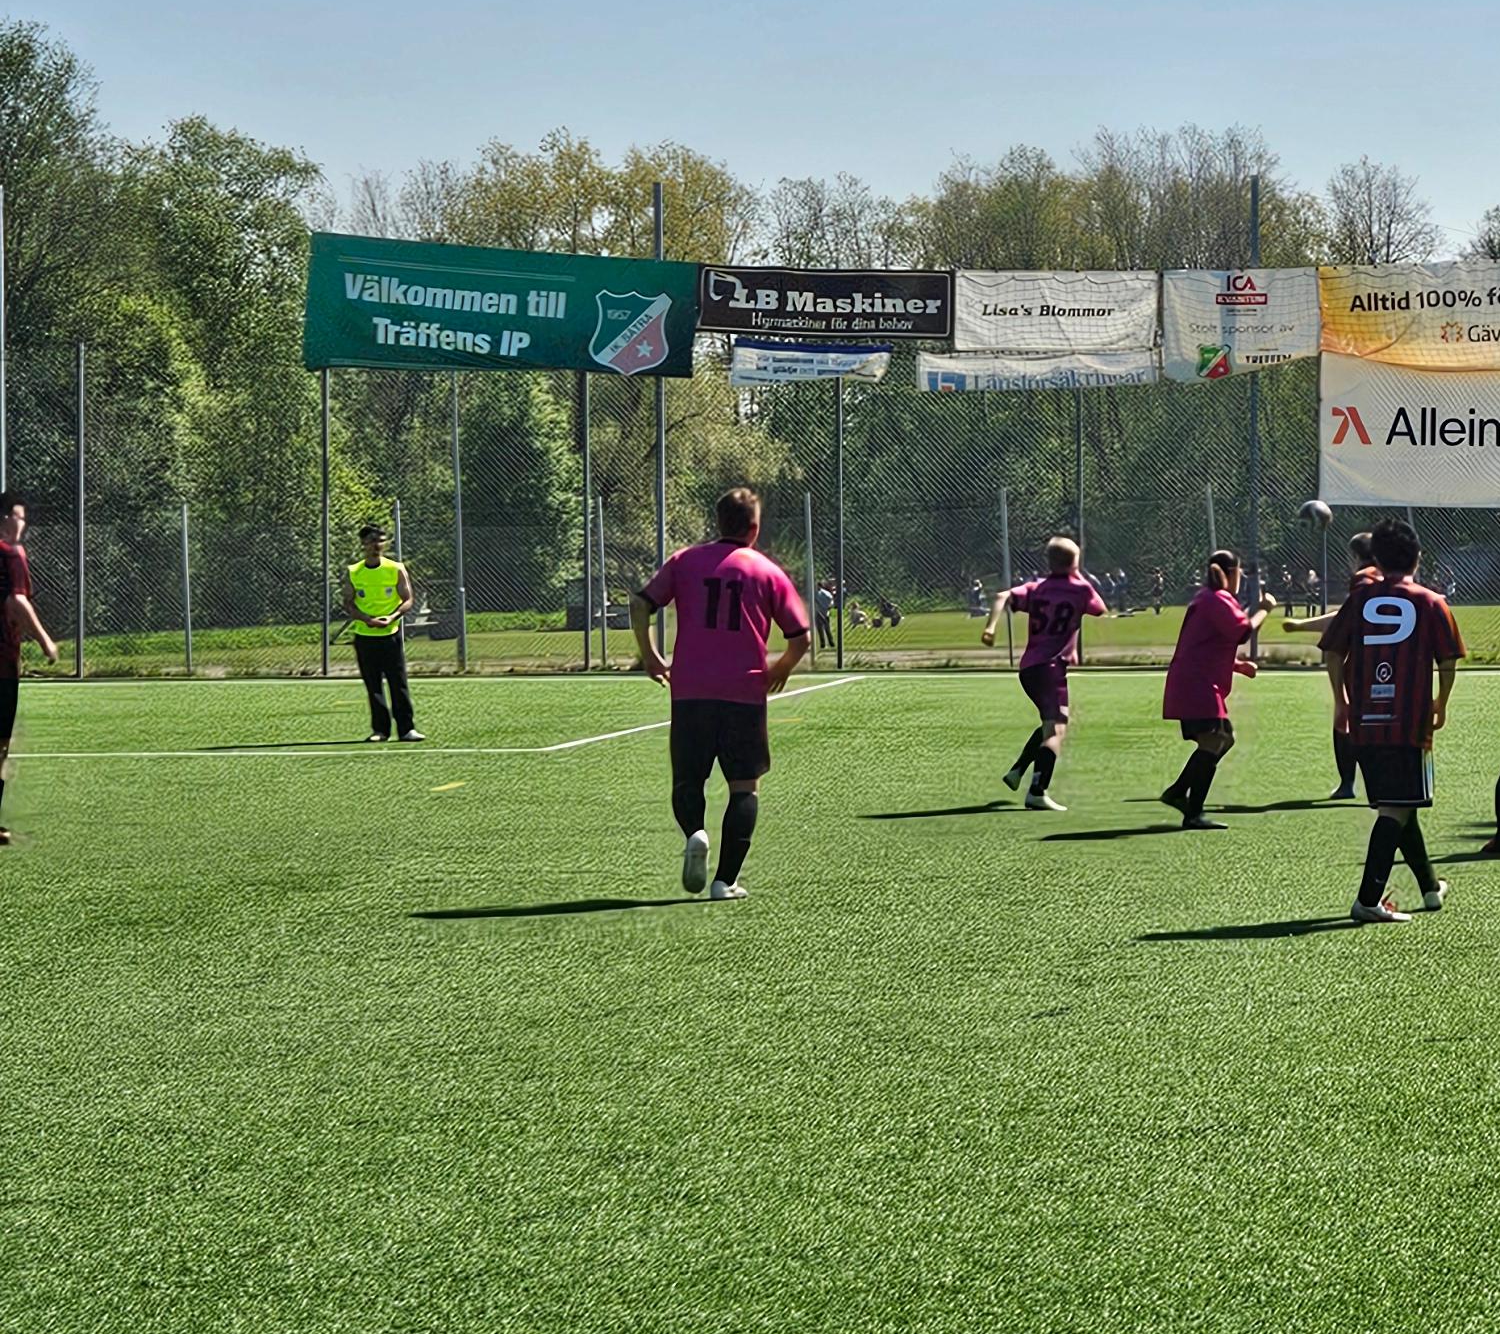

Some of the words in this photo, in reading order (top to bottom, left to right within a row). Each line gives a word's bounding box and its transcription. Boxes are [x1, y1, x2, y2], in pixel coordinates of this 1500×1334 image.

[344, 272, 518, 315] Välkommen
[527, 289, 567, 319] till
[1226, 275, 1256, 292] ICA
[785, 290, 942, 314] Maskiner
[982, 304, 1032, 317] Lisa's
[1039, 304, 1115, 318] Blommor
[1350, 291, 1410, 313] Alltid
[1415, 290, 1482, 310] 100%
[372, 317, 492, 355] Träffens
[500, 330, 531, 357] IP
[831, 317, 847, 330] för
[852, 317, 876, 330] dina
[703, 577, 744, 632] 11
[1031, 598, 1075, 636] 58
[1362, 596, 1417, 645] 9
